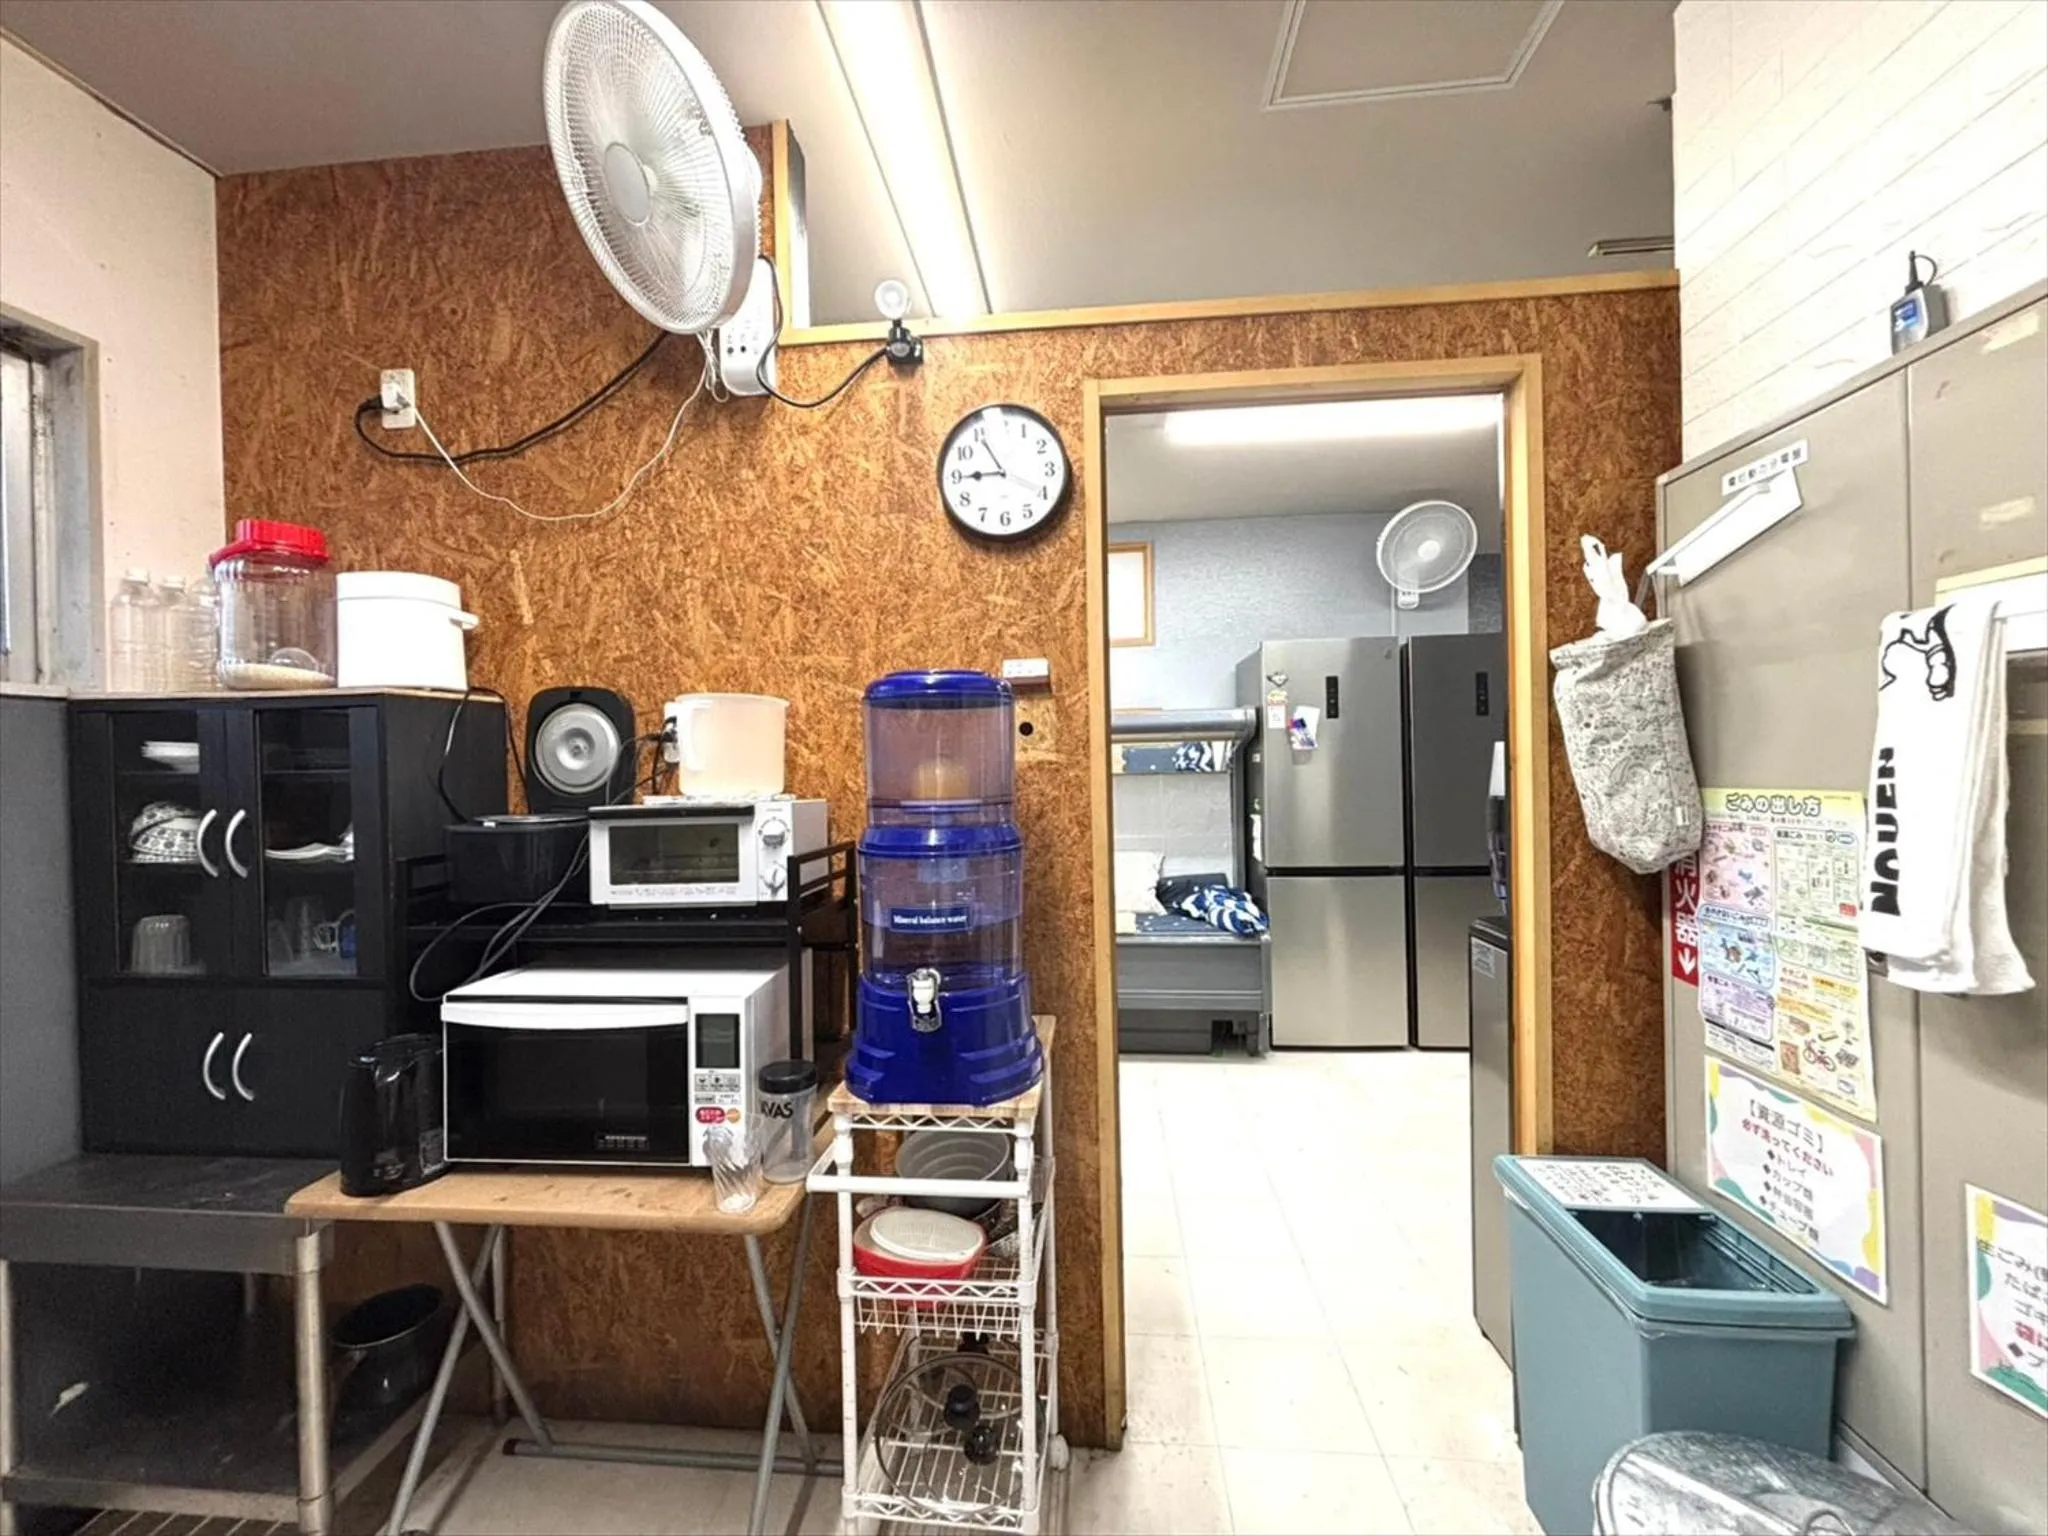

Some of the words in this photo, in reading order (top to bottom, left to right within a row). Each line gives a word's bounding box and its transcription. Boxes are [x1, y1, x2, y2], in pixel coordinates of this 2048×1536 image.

[1021, 424, 1026, 438] 1
[957, 446, 973, 460] 10
[1036, 439, 1047, 455] 2
[952, 470, 962, 484] 9
[1045, 462, 1055, 477] 3
[960, 492, 971, 507] 8
[1037, 485, 1048, 500] 4
[978, 507, 987, 523] 7
[1000, 511, 1011, 527] 6
[1023, 504, 1033, 519] 5
[1726, 792, 1822, 817] ごみの出し方
